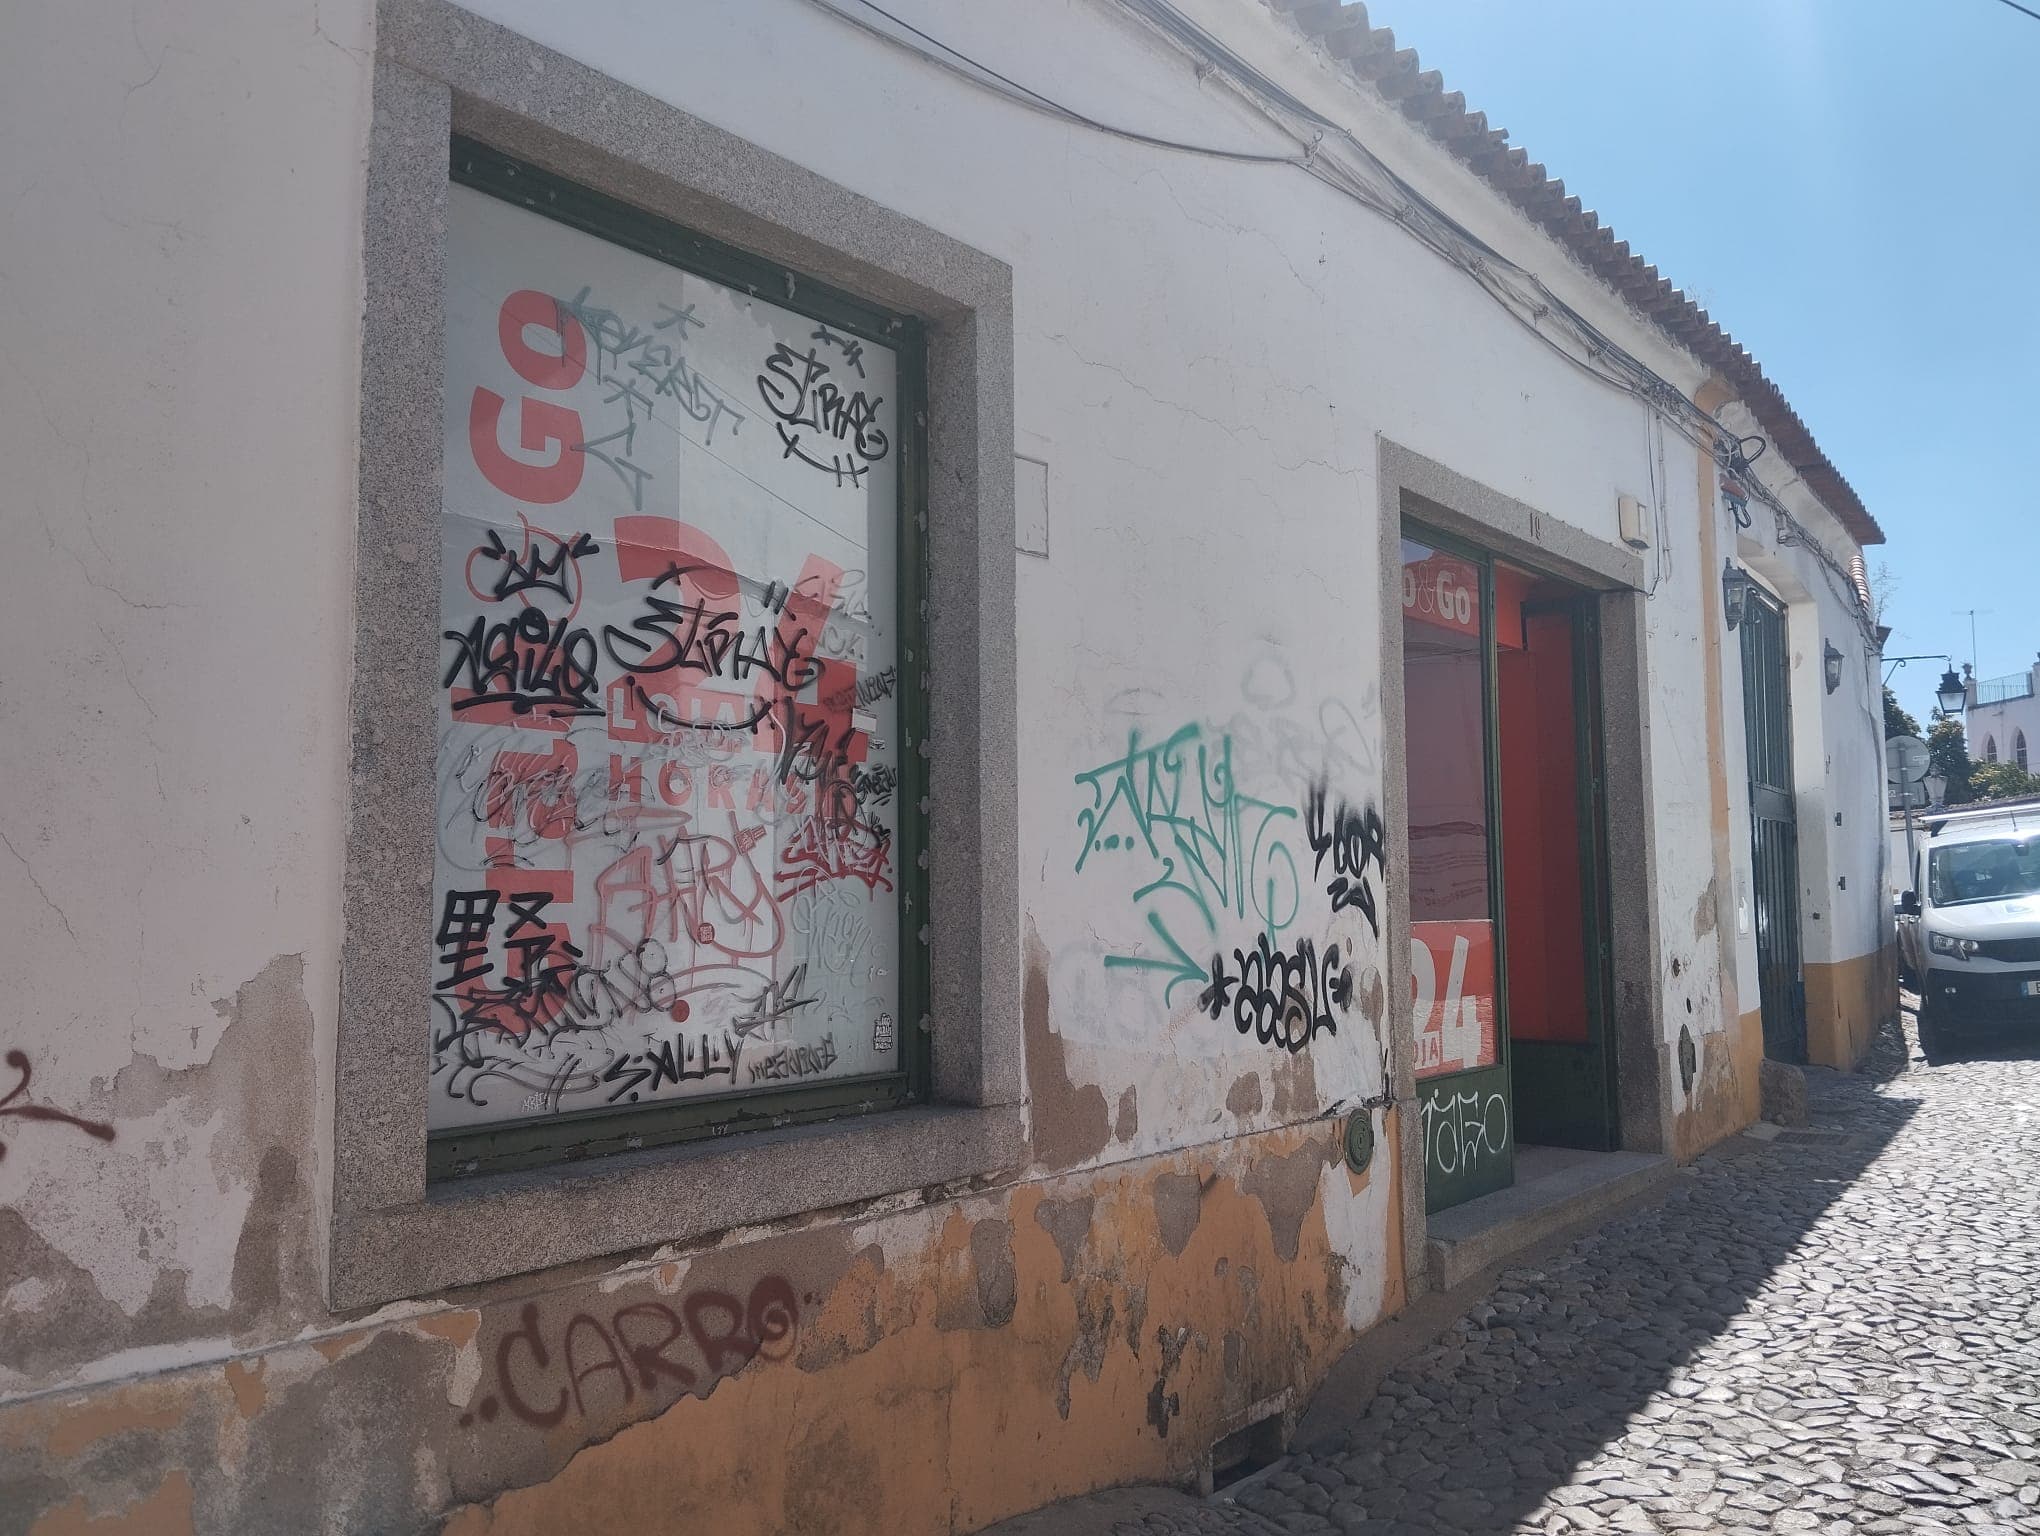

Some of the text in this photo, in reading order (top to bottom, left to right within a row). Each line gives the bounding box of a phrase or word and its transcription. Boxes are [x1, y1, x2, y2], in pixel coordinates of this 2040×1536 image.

[469, 290, 587, 504] Go
[606, 515, 868, 822] 24
[1437, 570, 1471, 624] Go
[608, 753, 807, 815] HORAS
[496, 1274, 800, 1428] CARRO
